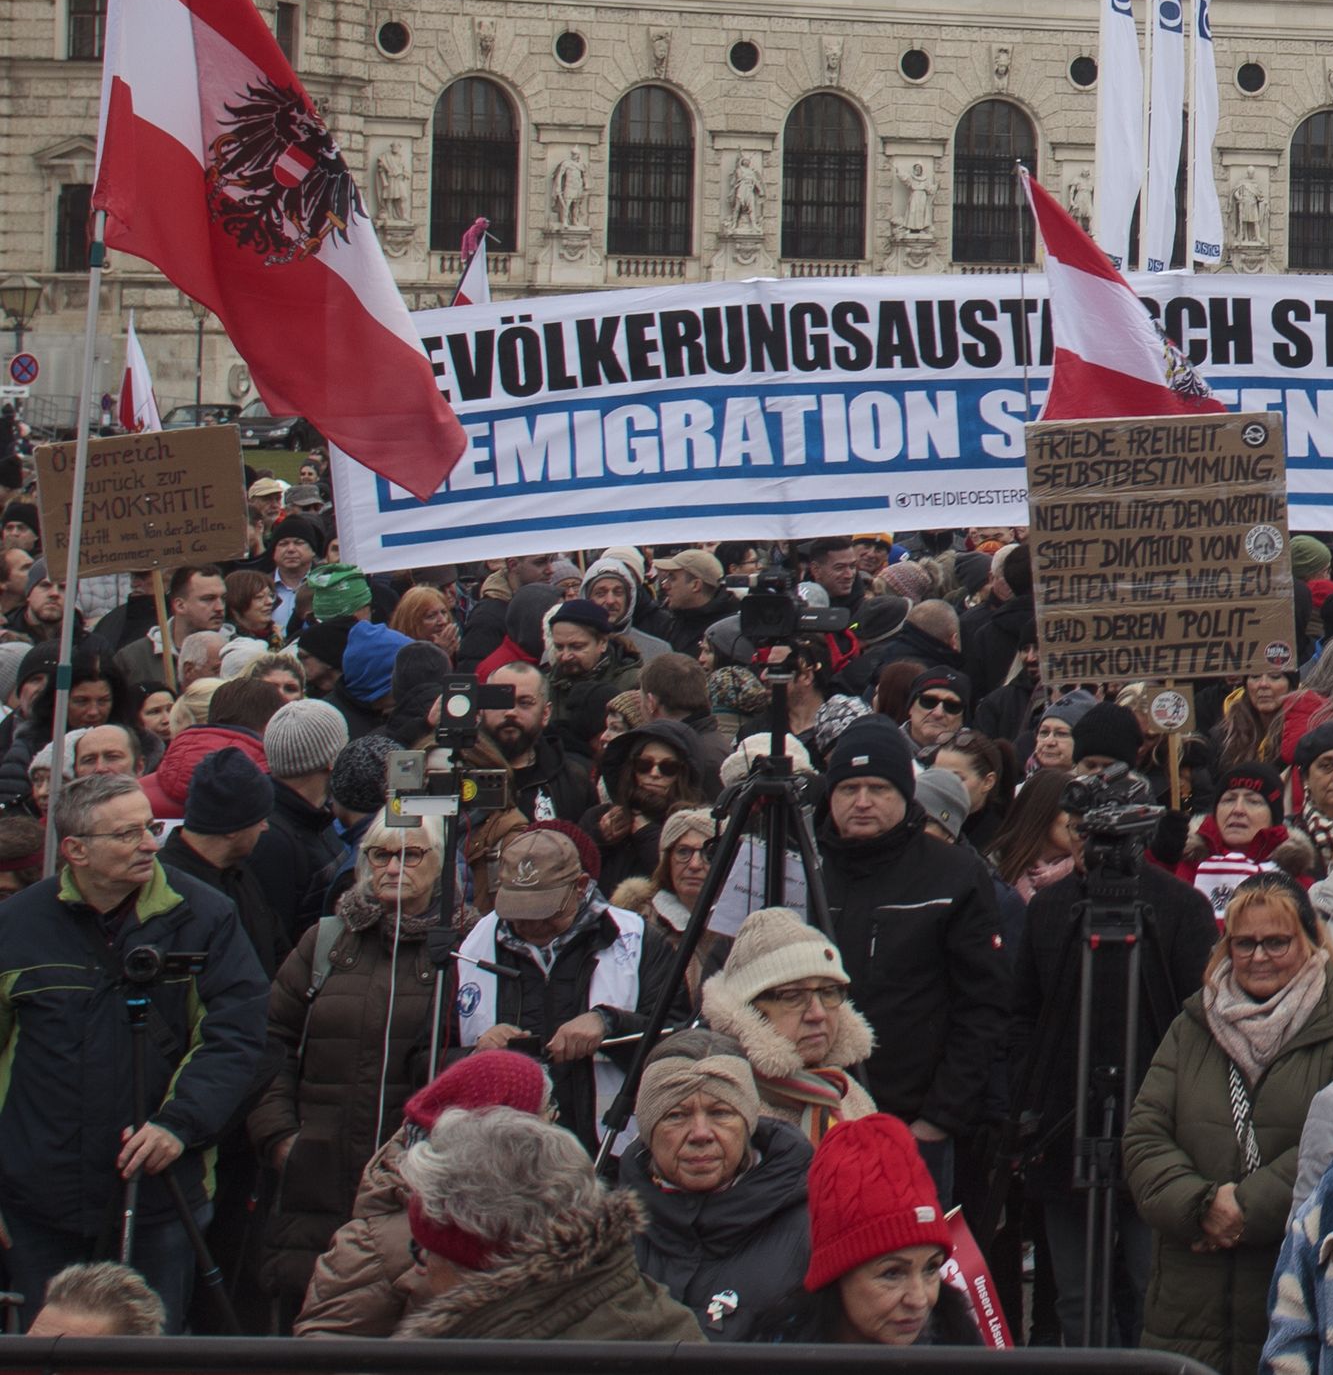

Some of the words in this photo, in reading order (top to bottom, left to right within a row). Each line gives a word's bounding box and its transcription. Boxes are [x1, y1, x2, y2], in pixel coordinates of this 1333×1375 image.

[421, 297, 1253, 403] EVÖLKERUNGSAUSTCH
[390, 390, 961, 500] EMIGRATION
[1034, 429, 1121, 460] FRIEDE,
[1126, 423, 1223, 456] FREIHEIT,
[156, 470, 188, 486] zur
[1032, 454, 1278, 489] SELBSTBESTIMMUNG,
[120, 531, 138, 542] von
[164, 523, 184, 538] der
[163, 544, 184, 556] und
[1037, 537, 1100, 571] STATT
[1099, 535, 1193, 568] DIKTATUR
[1200, 534, 1242, 561] VON
[1044, 618, 1086, 643] UND
[1092, 612, 1168, 641] DEREN
[1046, 640, 1259, 680] MARIONETTEN!
[974, 1274, 994, 1317] Unsere
[988, 1316, 1006, 1350] Lösu
